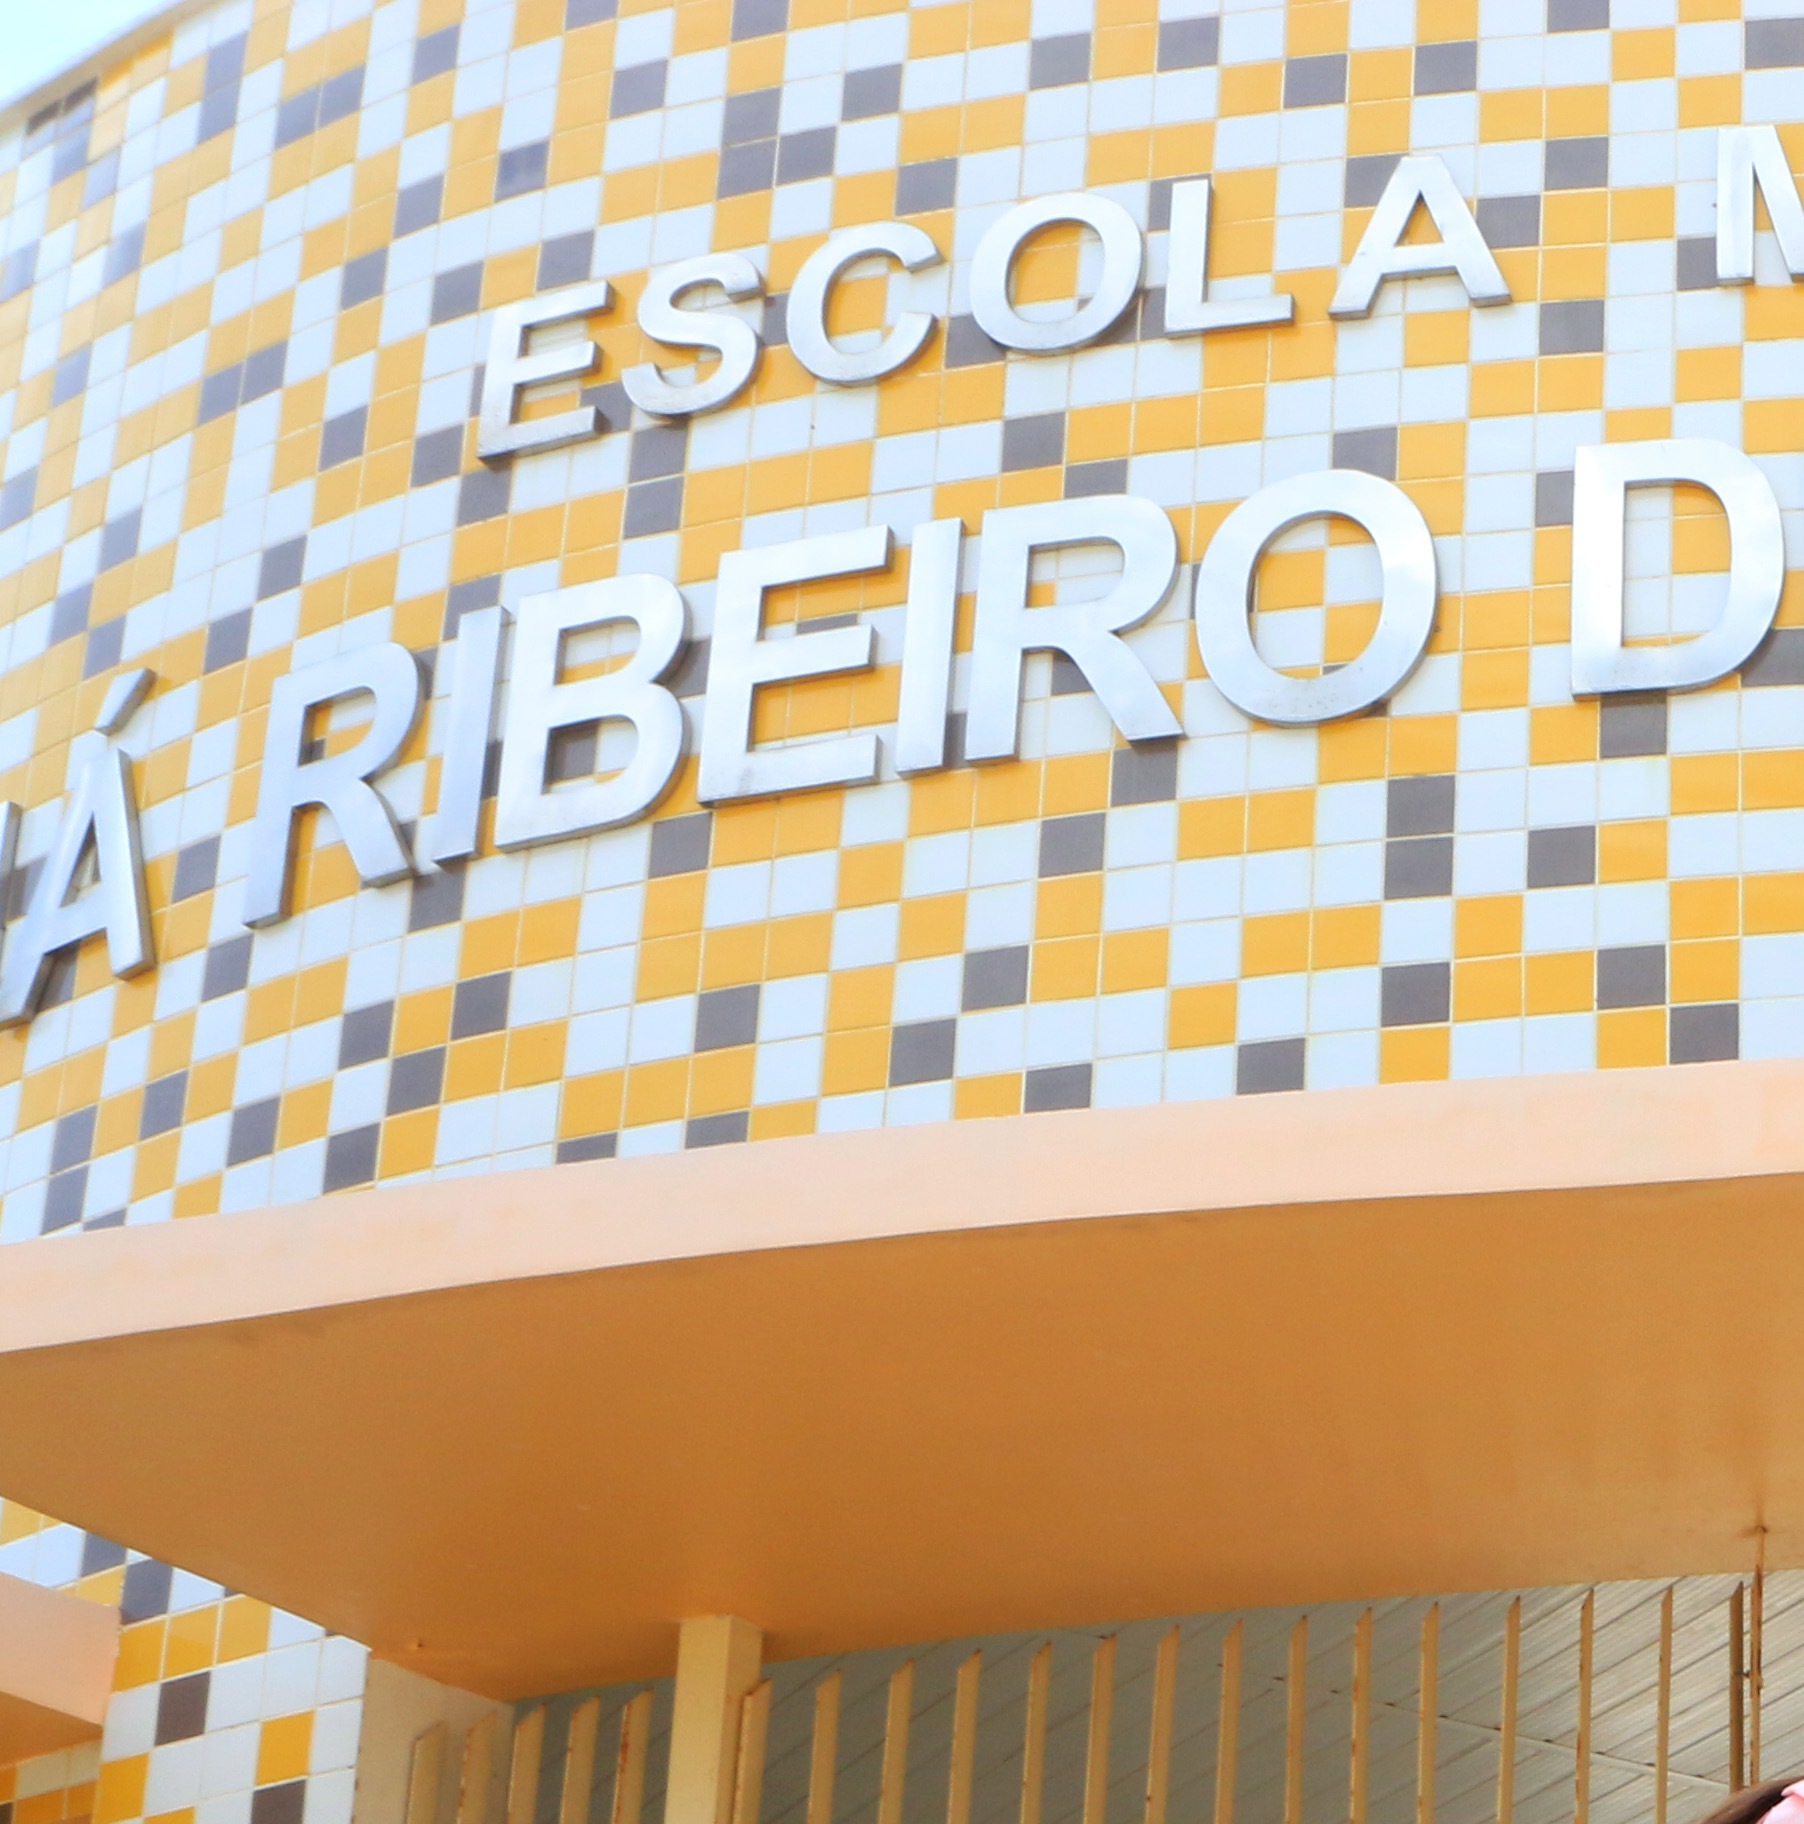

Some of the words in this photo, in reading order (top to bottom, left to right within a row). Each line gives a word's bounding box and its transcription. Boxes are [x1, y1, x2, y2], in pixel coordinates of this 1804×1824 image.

[475, 154, 1511, 465] ESCOLA
[0, 667, 156, 1031] Á
[242, 466, 1443, 931] RIBEIRO
